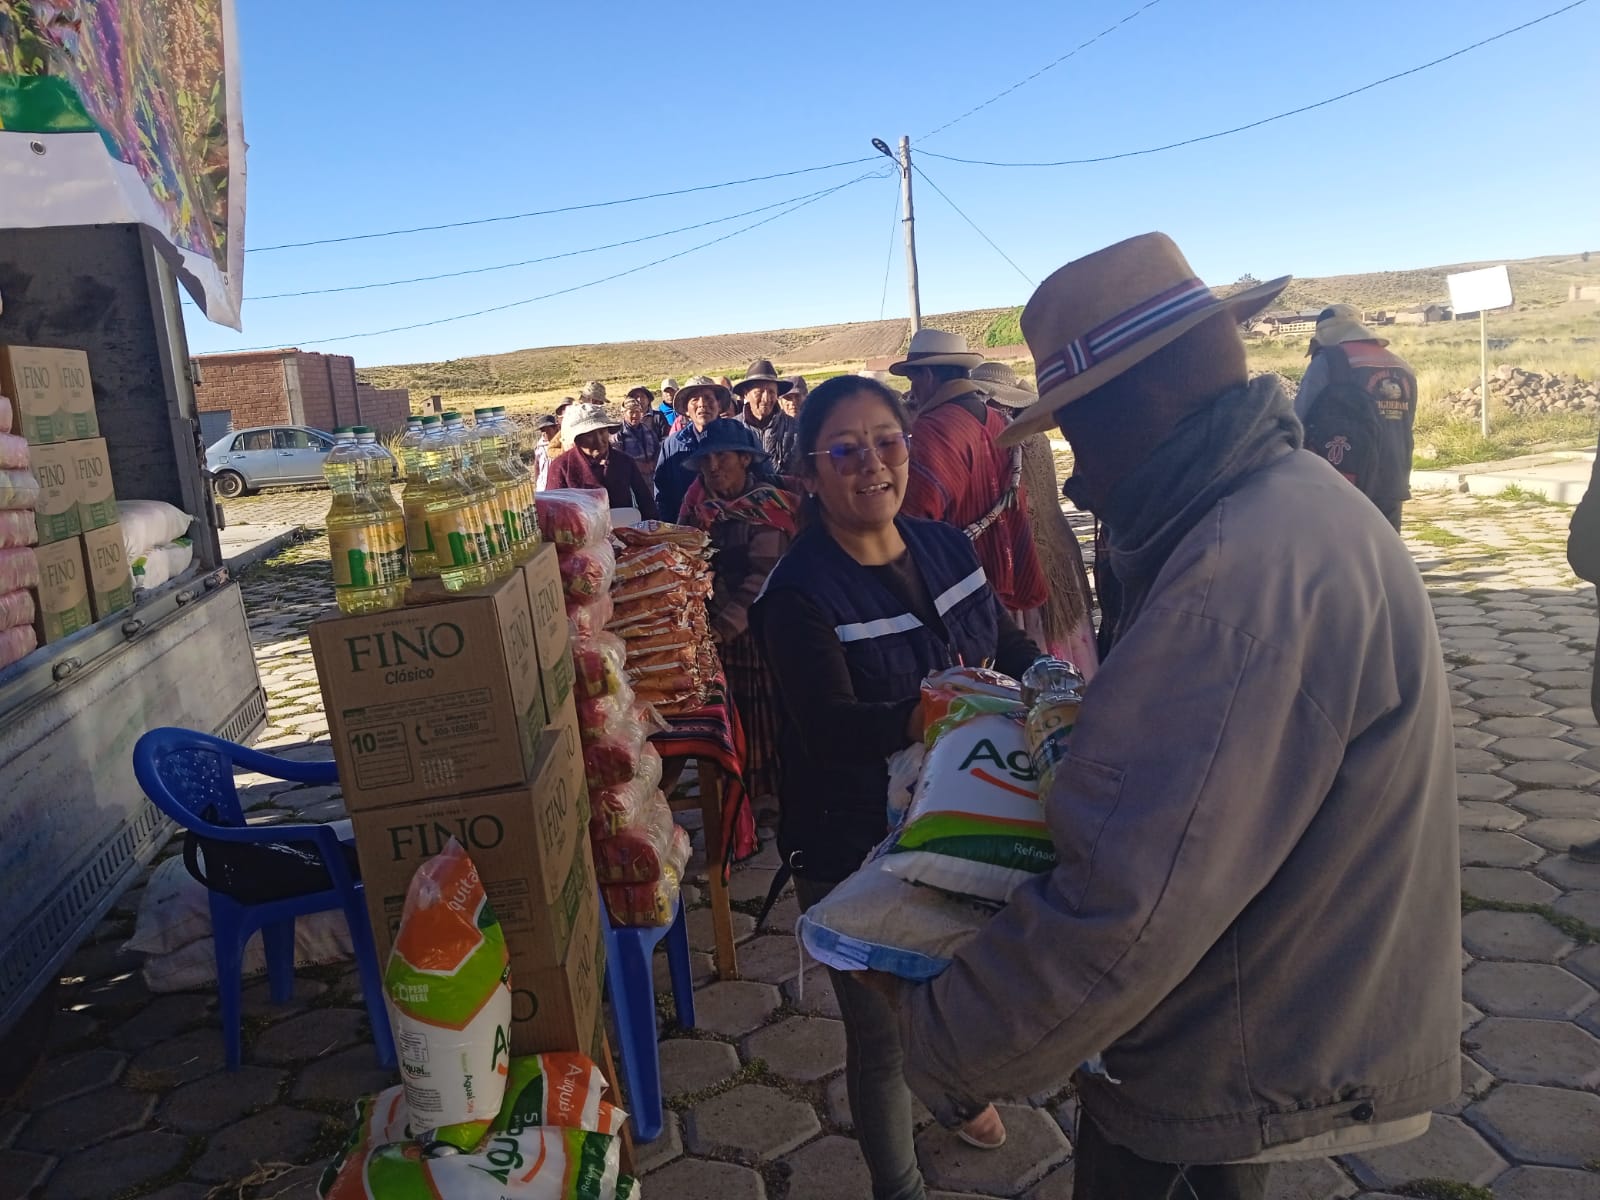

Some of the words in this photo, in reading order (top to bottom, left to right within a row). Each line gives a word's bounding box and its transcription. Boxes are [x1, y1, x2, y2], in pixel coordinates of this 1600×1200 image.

[23, 366, 50, 390] FINO
[62, 367, 86, 390] FINO
[39, 463, 65, 490] FINO
[79, 454, 104, 482] FINO
[97, 542, 122, 572] FINO
[46, 557, 76, 589] FINO
[344, 621, 466, 674] FINO
[384, 667, 435, 686] Clásico
[351, 732, 377, 754] 10
[957, 738, 1038, 782] Ag
[545, 776, 568, 850] FINO
[387, 814, 505, 863] FINO
[408, 983, 429, 994] PESO
